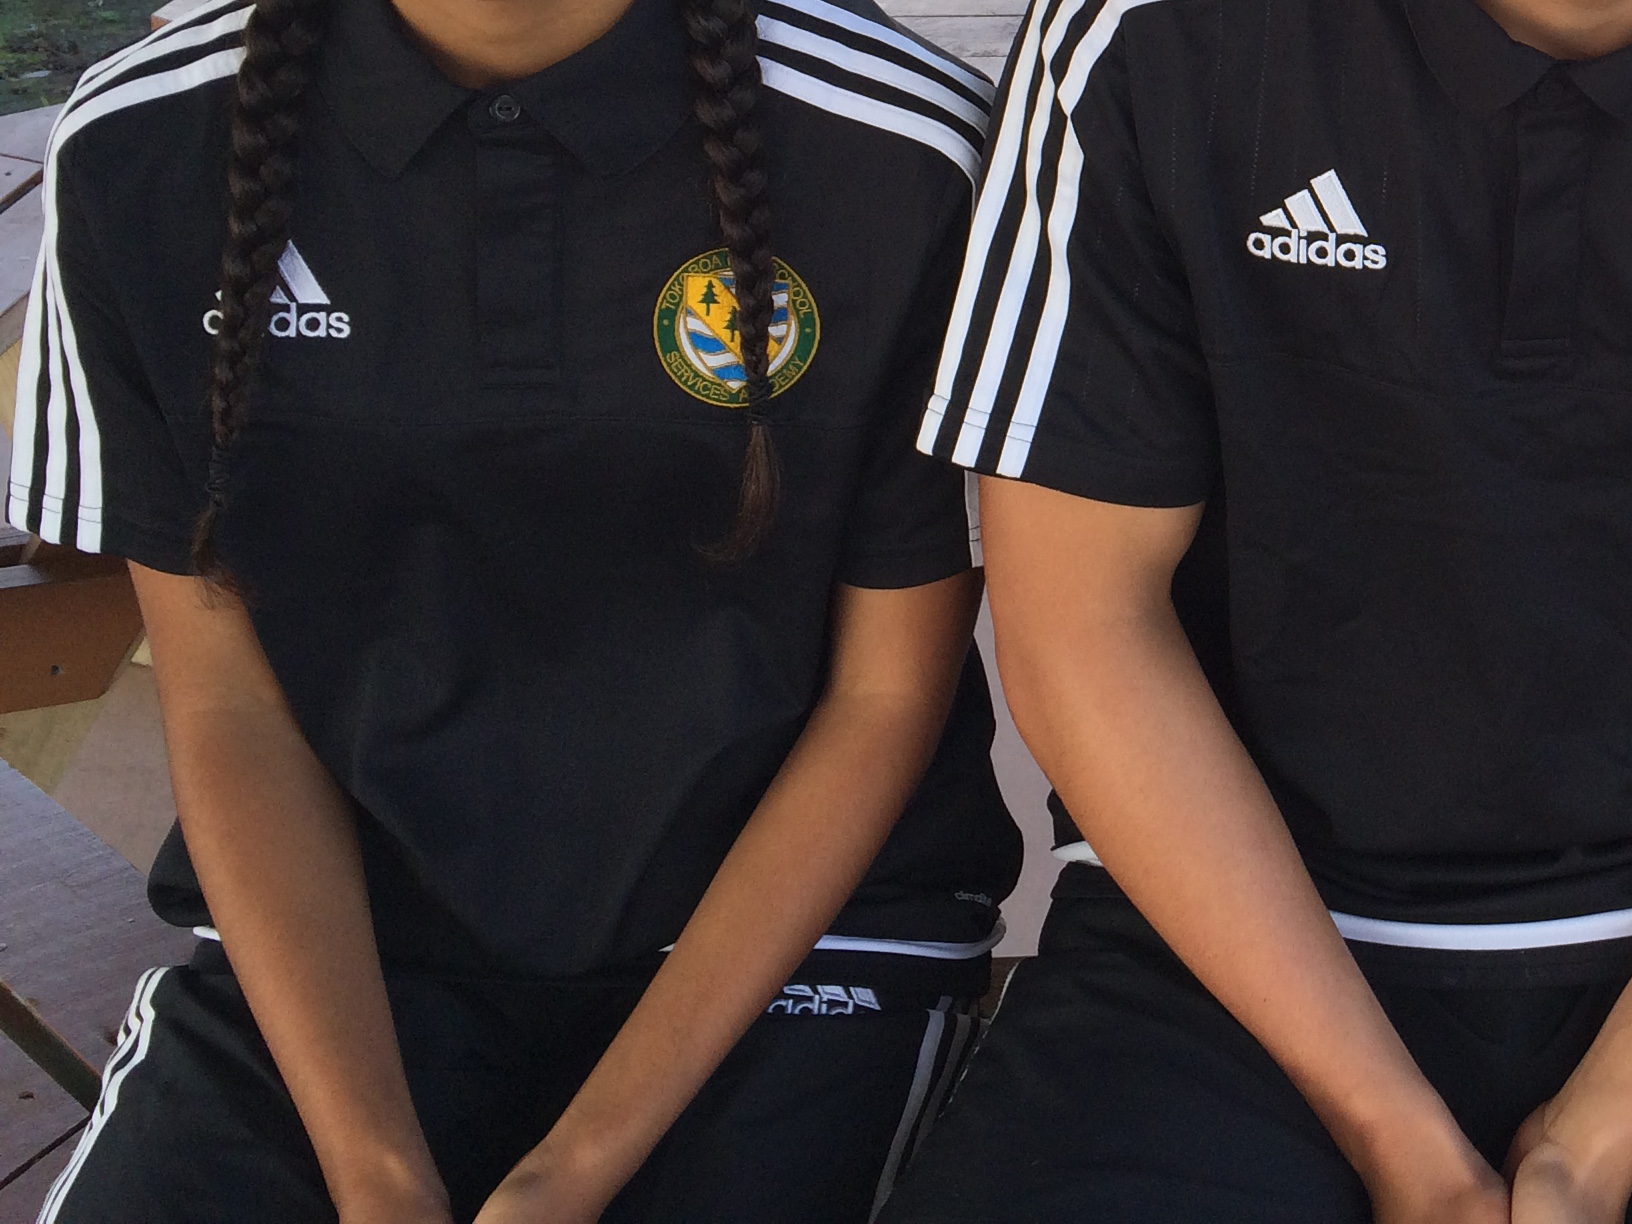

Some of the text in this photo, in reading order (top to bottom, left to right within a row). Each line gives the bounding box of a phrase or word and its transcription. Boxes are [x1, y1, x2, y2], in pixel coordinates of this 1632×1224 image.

[1246, 228, 1387, 270] adidas
[202, 301, 351, 339] adas
[666, 351, 805, 403] SERVICES ADEMY
